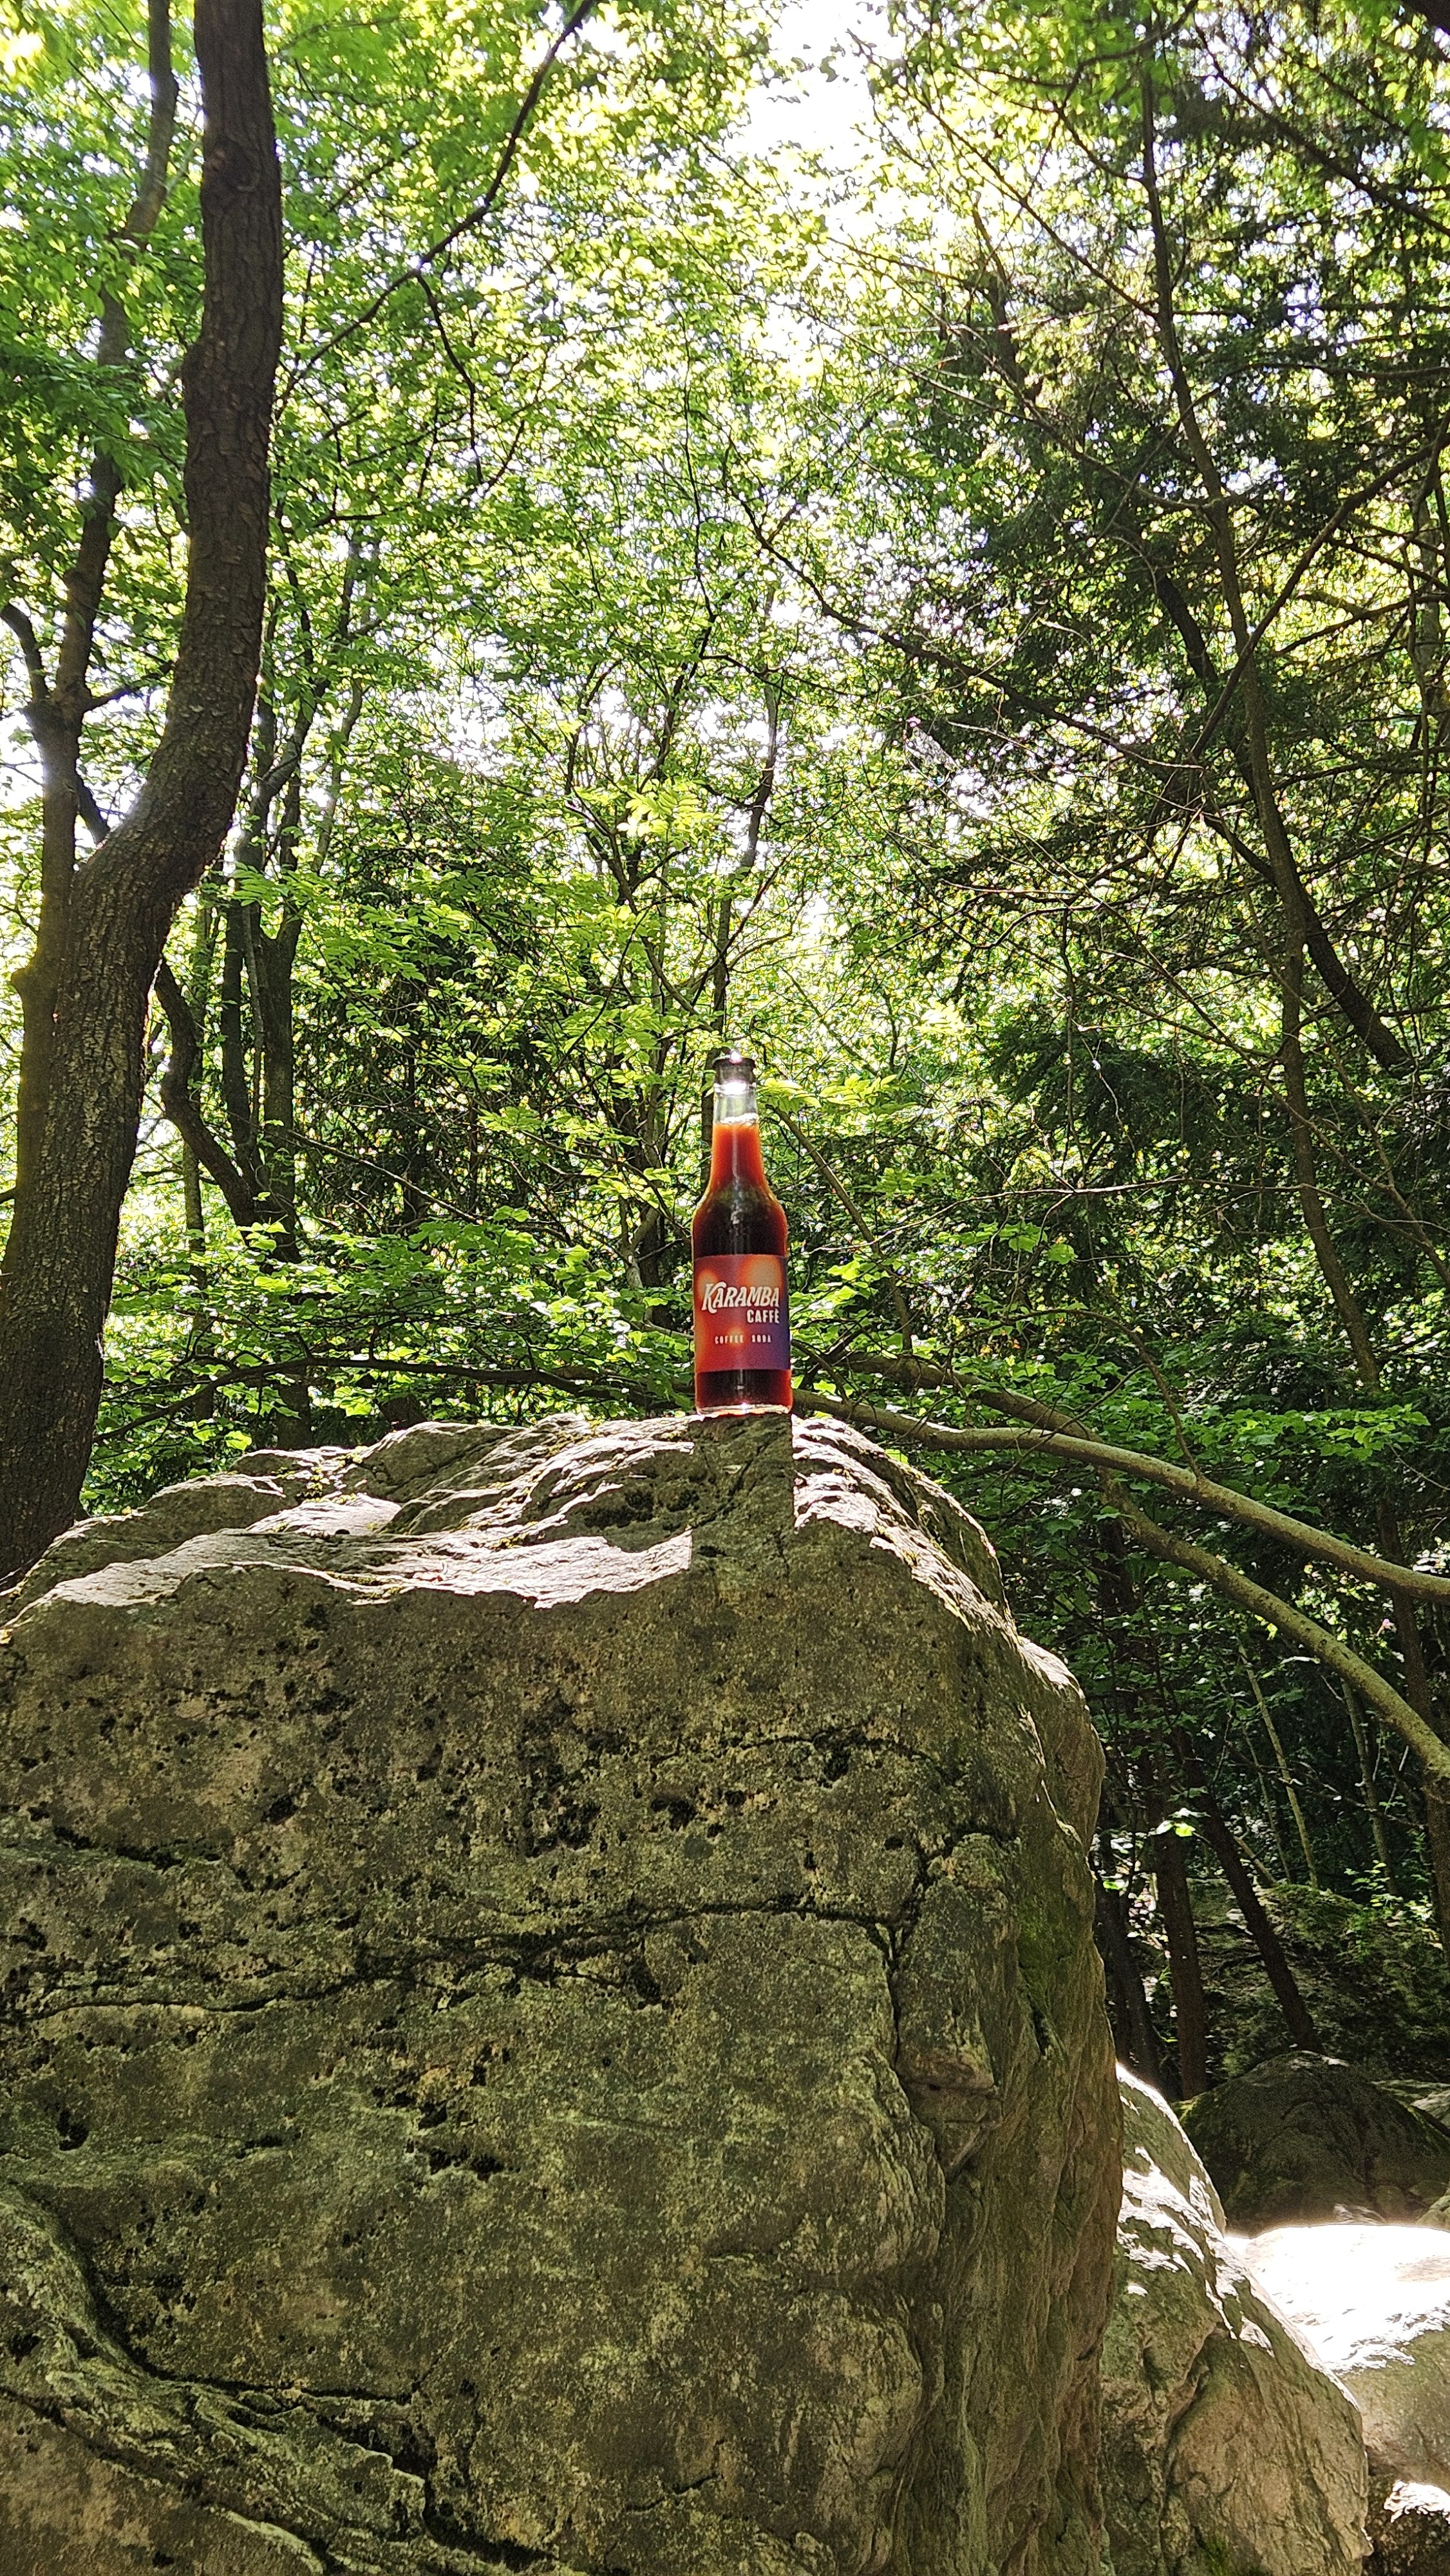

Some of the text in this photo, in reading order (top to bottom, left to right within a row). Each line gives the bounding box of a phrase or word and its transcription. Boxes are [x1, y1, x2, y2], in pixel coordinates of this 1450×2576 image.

[701, 1282, 780, 1314] KARAMBA
[714, 1334, 771, 1344] COFFEE SODA
